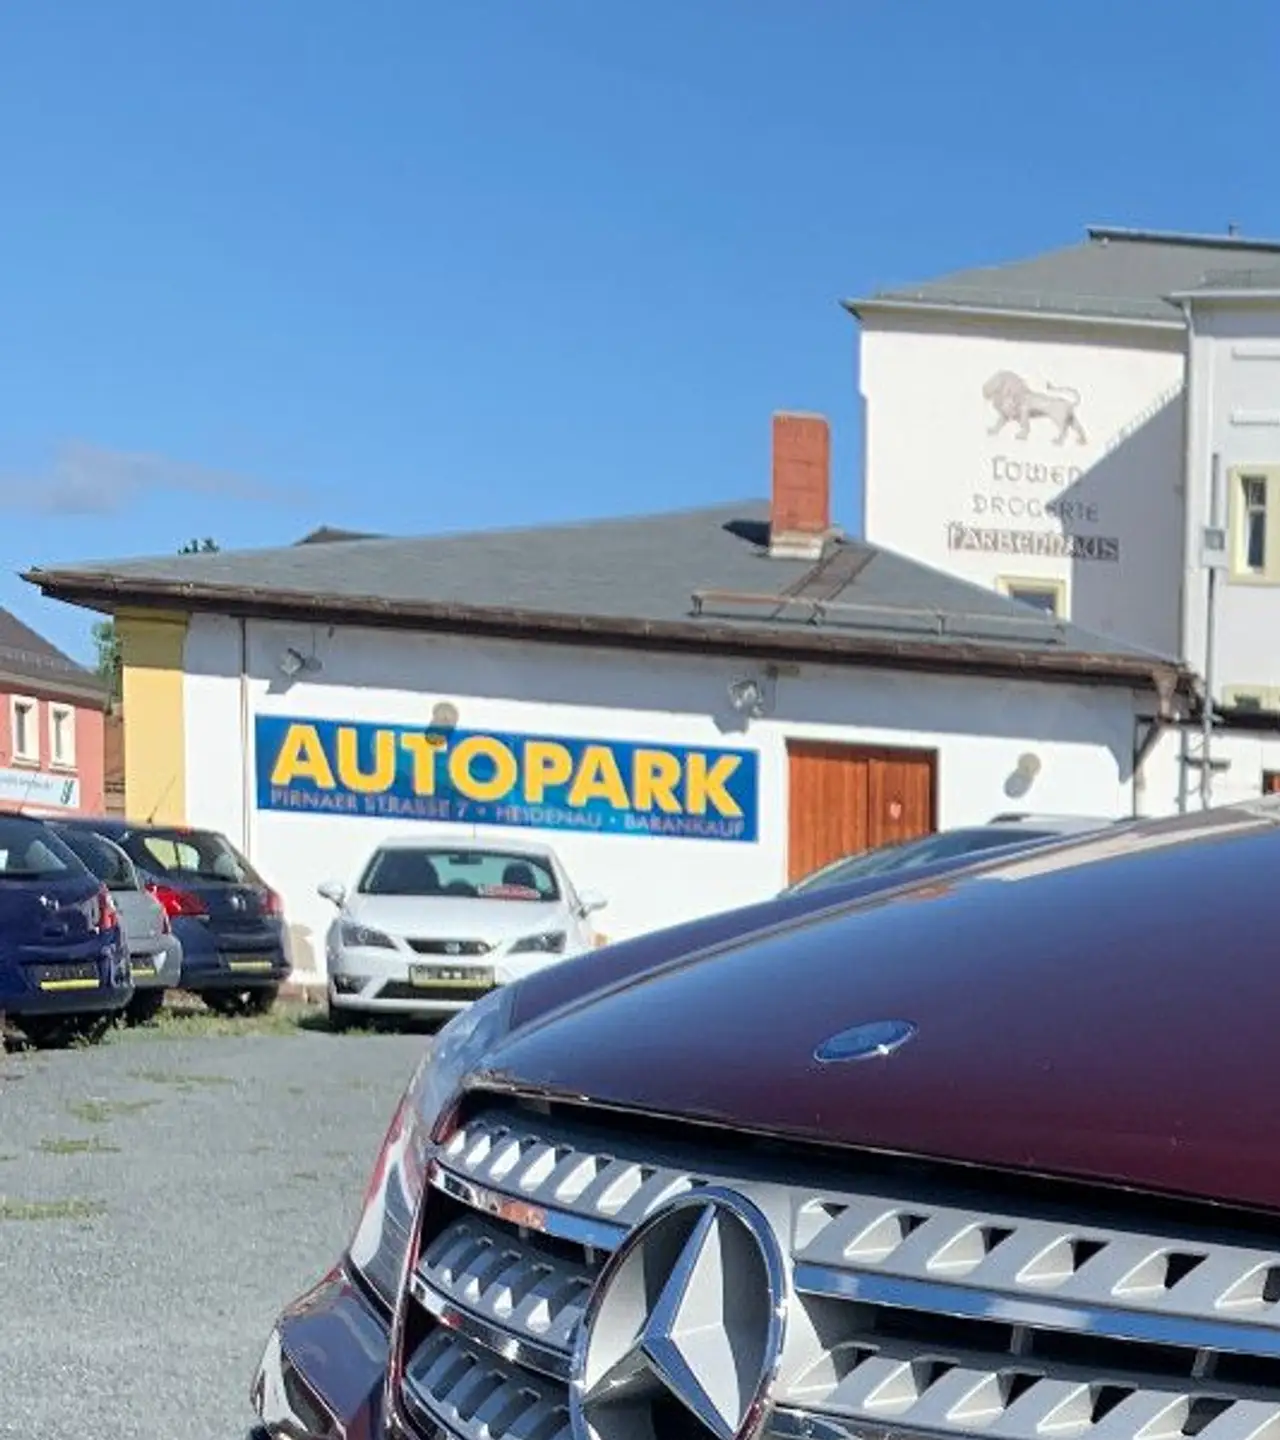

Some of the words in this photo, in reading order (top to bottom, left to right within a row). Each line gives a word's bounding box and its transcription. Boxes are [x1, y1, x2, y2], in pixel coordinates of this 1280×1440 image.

[270, 723, 743, 817] AUTOPARK
[271, 789, 357, 812] PIRNAER
[365, 796, 450, 819] STRASSE
[456, 804, 468, 818] 7
[624, 813, 745, 837] BARANKAUF
